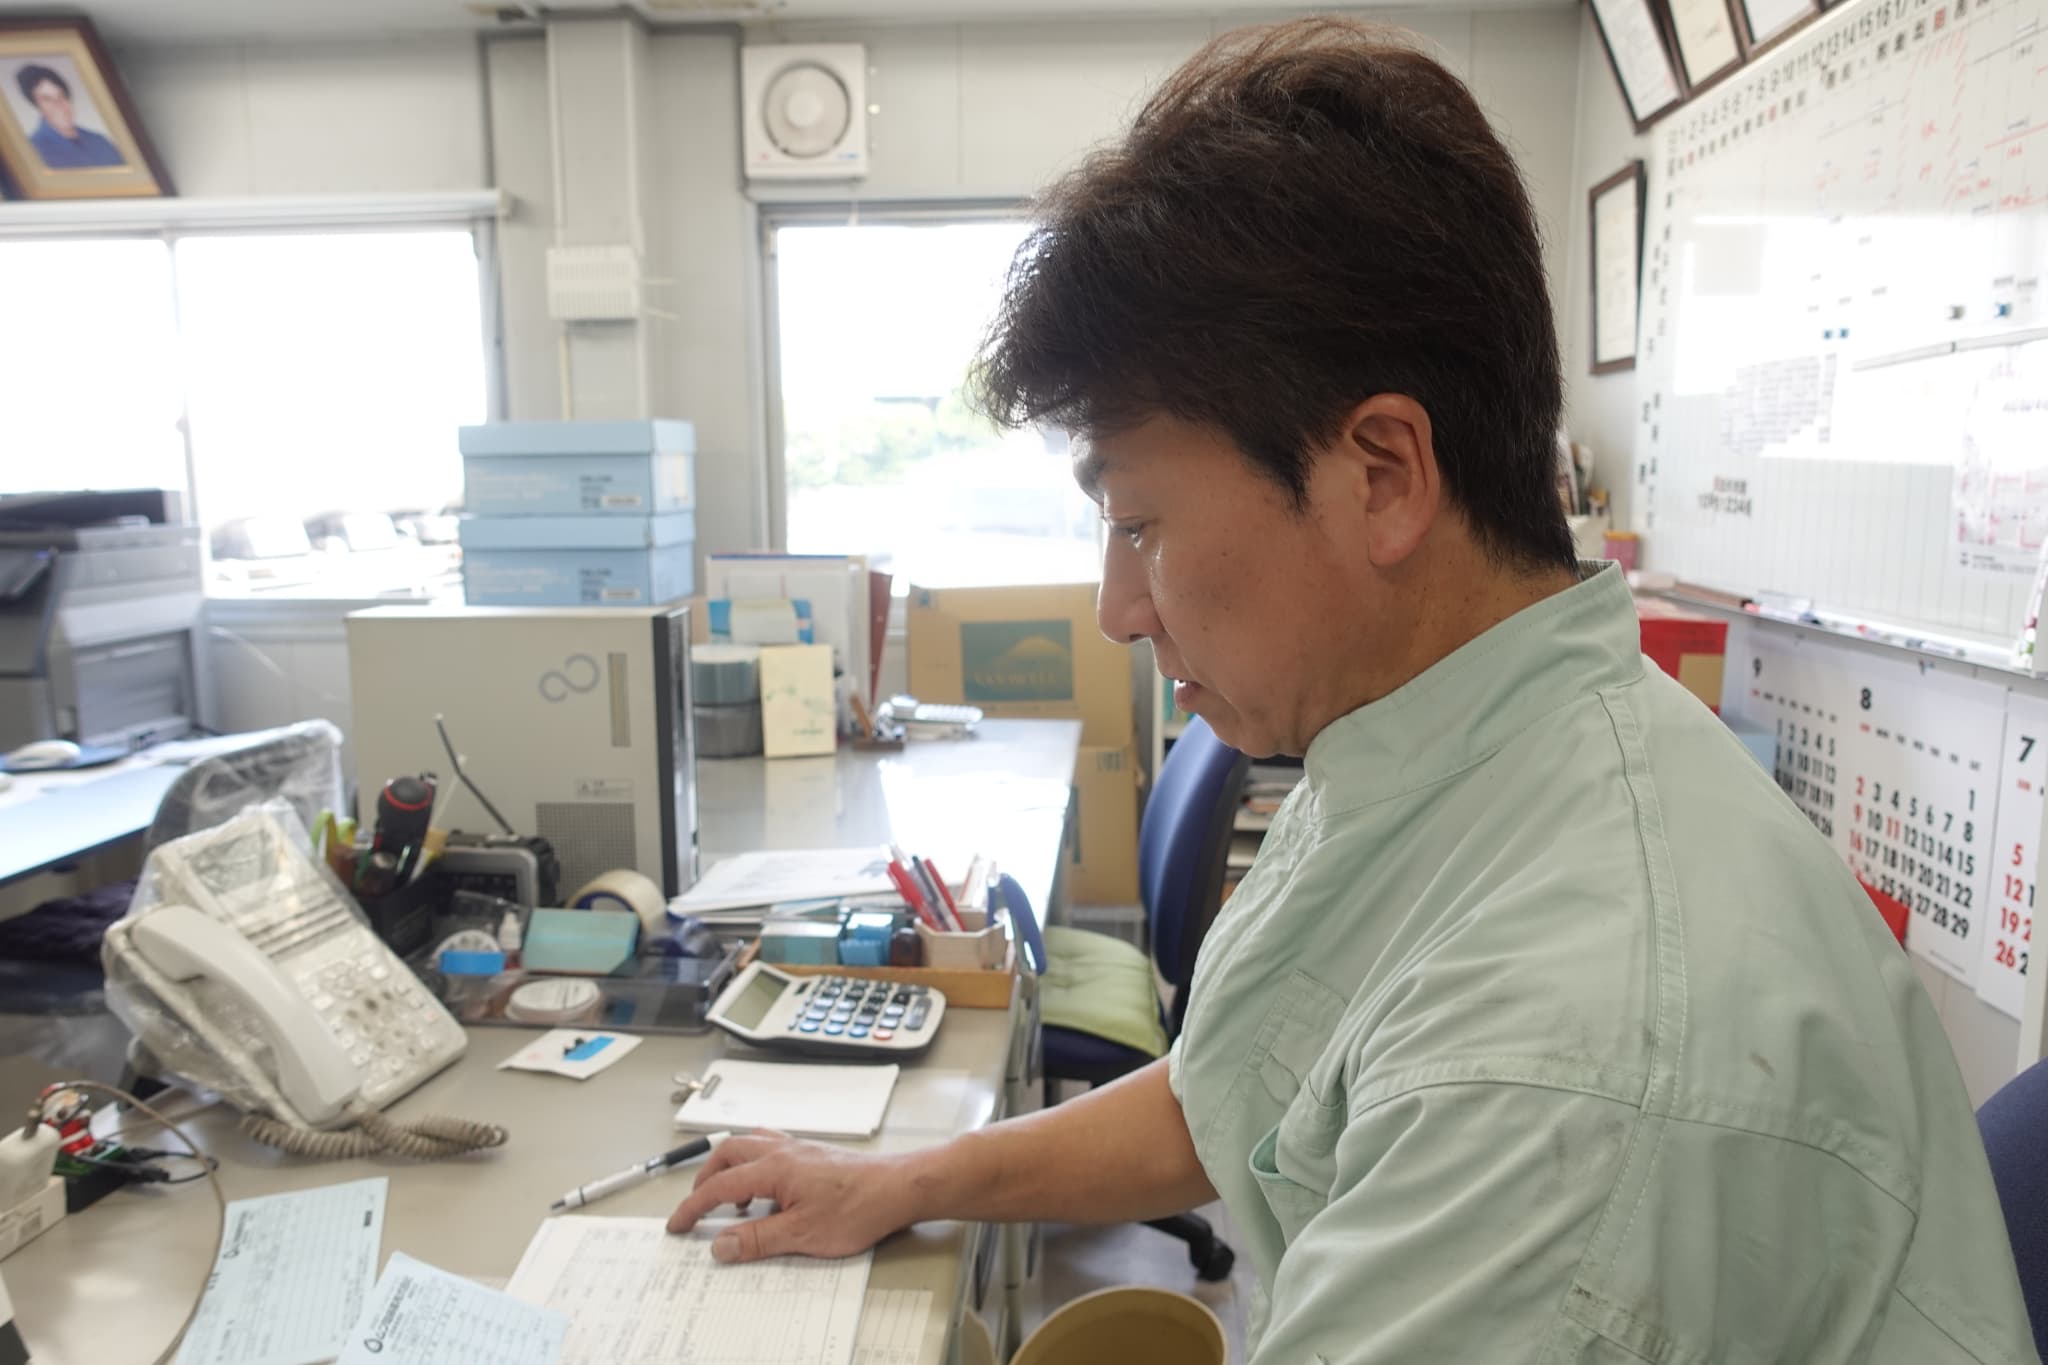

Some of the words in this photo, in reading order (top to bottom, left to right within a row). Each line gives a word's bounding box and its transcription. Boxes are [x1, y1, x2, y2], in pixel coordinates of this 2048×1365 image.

[1753, 657, 1762, 678] 9
[1860, 688, 1872, 710] 8
[1789, 722, 1796, 742] 2
[1802, 728, 1808, 746] 3
[1815, 732, 1822, 751] 4
[2018, 736, 2036, 763] 7
[1797, 752, 1810, 773] 10
[1811, 757, 1823, 778] 11
[1825, 764, 1836, 785] 12
[1856, 776, 1864, 796] 2
[1873, 782, 1882, 802] 3
[1890, 789, 1900, 810] 4
[1910, 798, 1918, 818] 5
[1926, 804, 1934, 826] 6
[1944, 812, 1954, 833] 7
[1964, 821, 1974, 842] 8
[1968, 788, 1976, 811] 1
[1854, 802, 1862, 822] 9
[1867, 808, 1882, 832] 10
[1886, 816, 1900, 840] 11
[1904, 825, 1918, 848] 12
[1921, 832, 1935, 857] 13
[1938, 842, 1952, 866] 14
[1958, 851, 1974, 876] 15
[2012, 843, 2023, 866] 5
[1850, 829, 1862, 852] 16
[1866, 836, 1880, 858] 17
[1883, 846, 1898, 870] 18
[1901, 853, 1915, 877] 19
[1918, 862, 1934, 888] 20
[1936, 872, 1950, 898] 21
[1954, 882, 1973, 909] 22
[2005, 874, 2024, 902] 12
[2028, 884, 2034, 908] 1
[1880, 874, 1895, 897] 25
[1916, 892, 1931, 916] 27
[1932, 902, 1948, 929] 28
[1951, 912, 1969, 940] 29
[2002, 907, 2019, 934] 19
[1994, 939, 2016, 969] 26
[2019, 952, 2028, 976] 2
